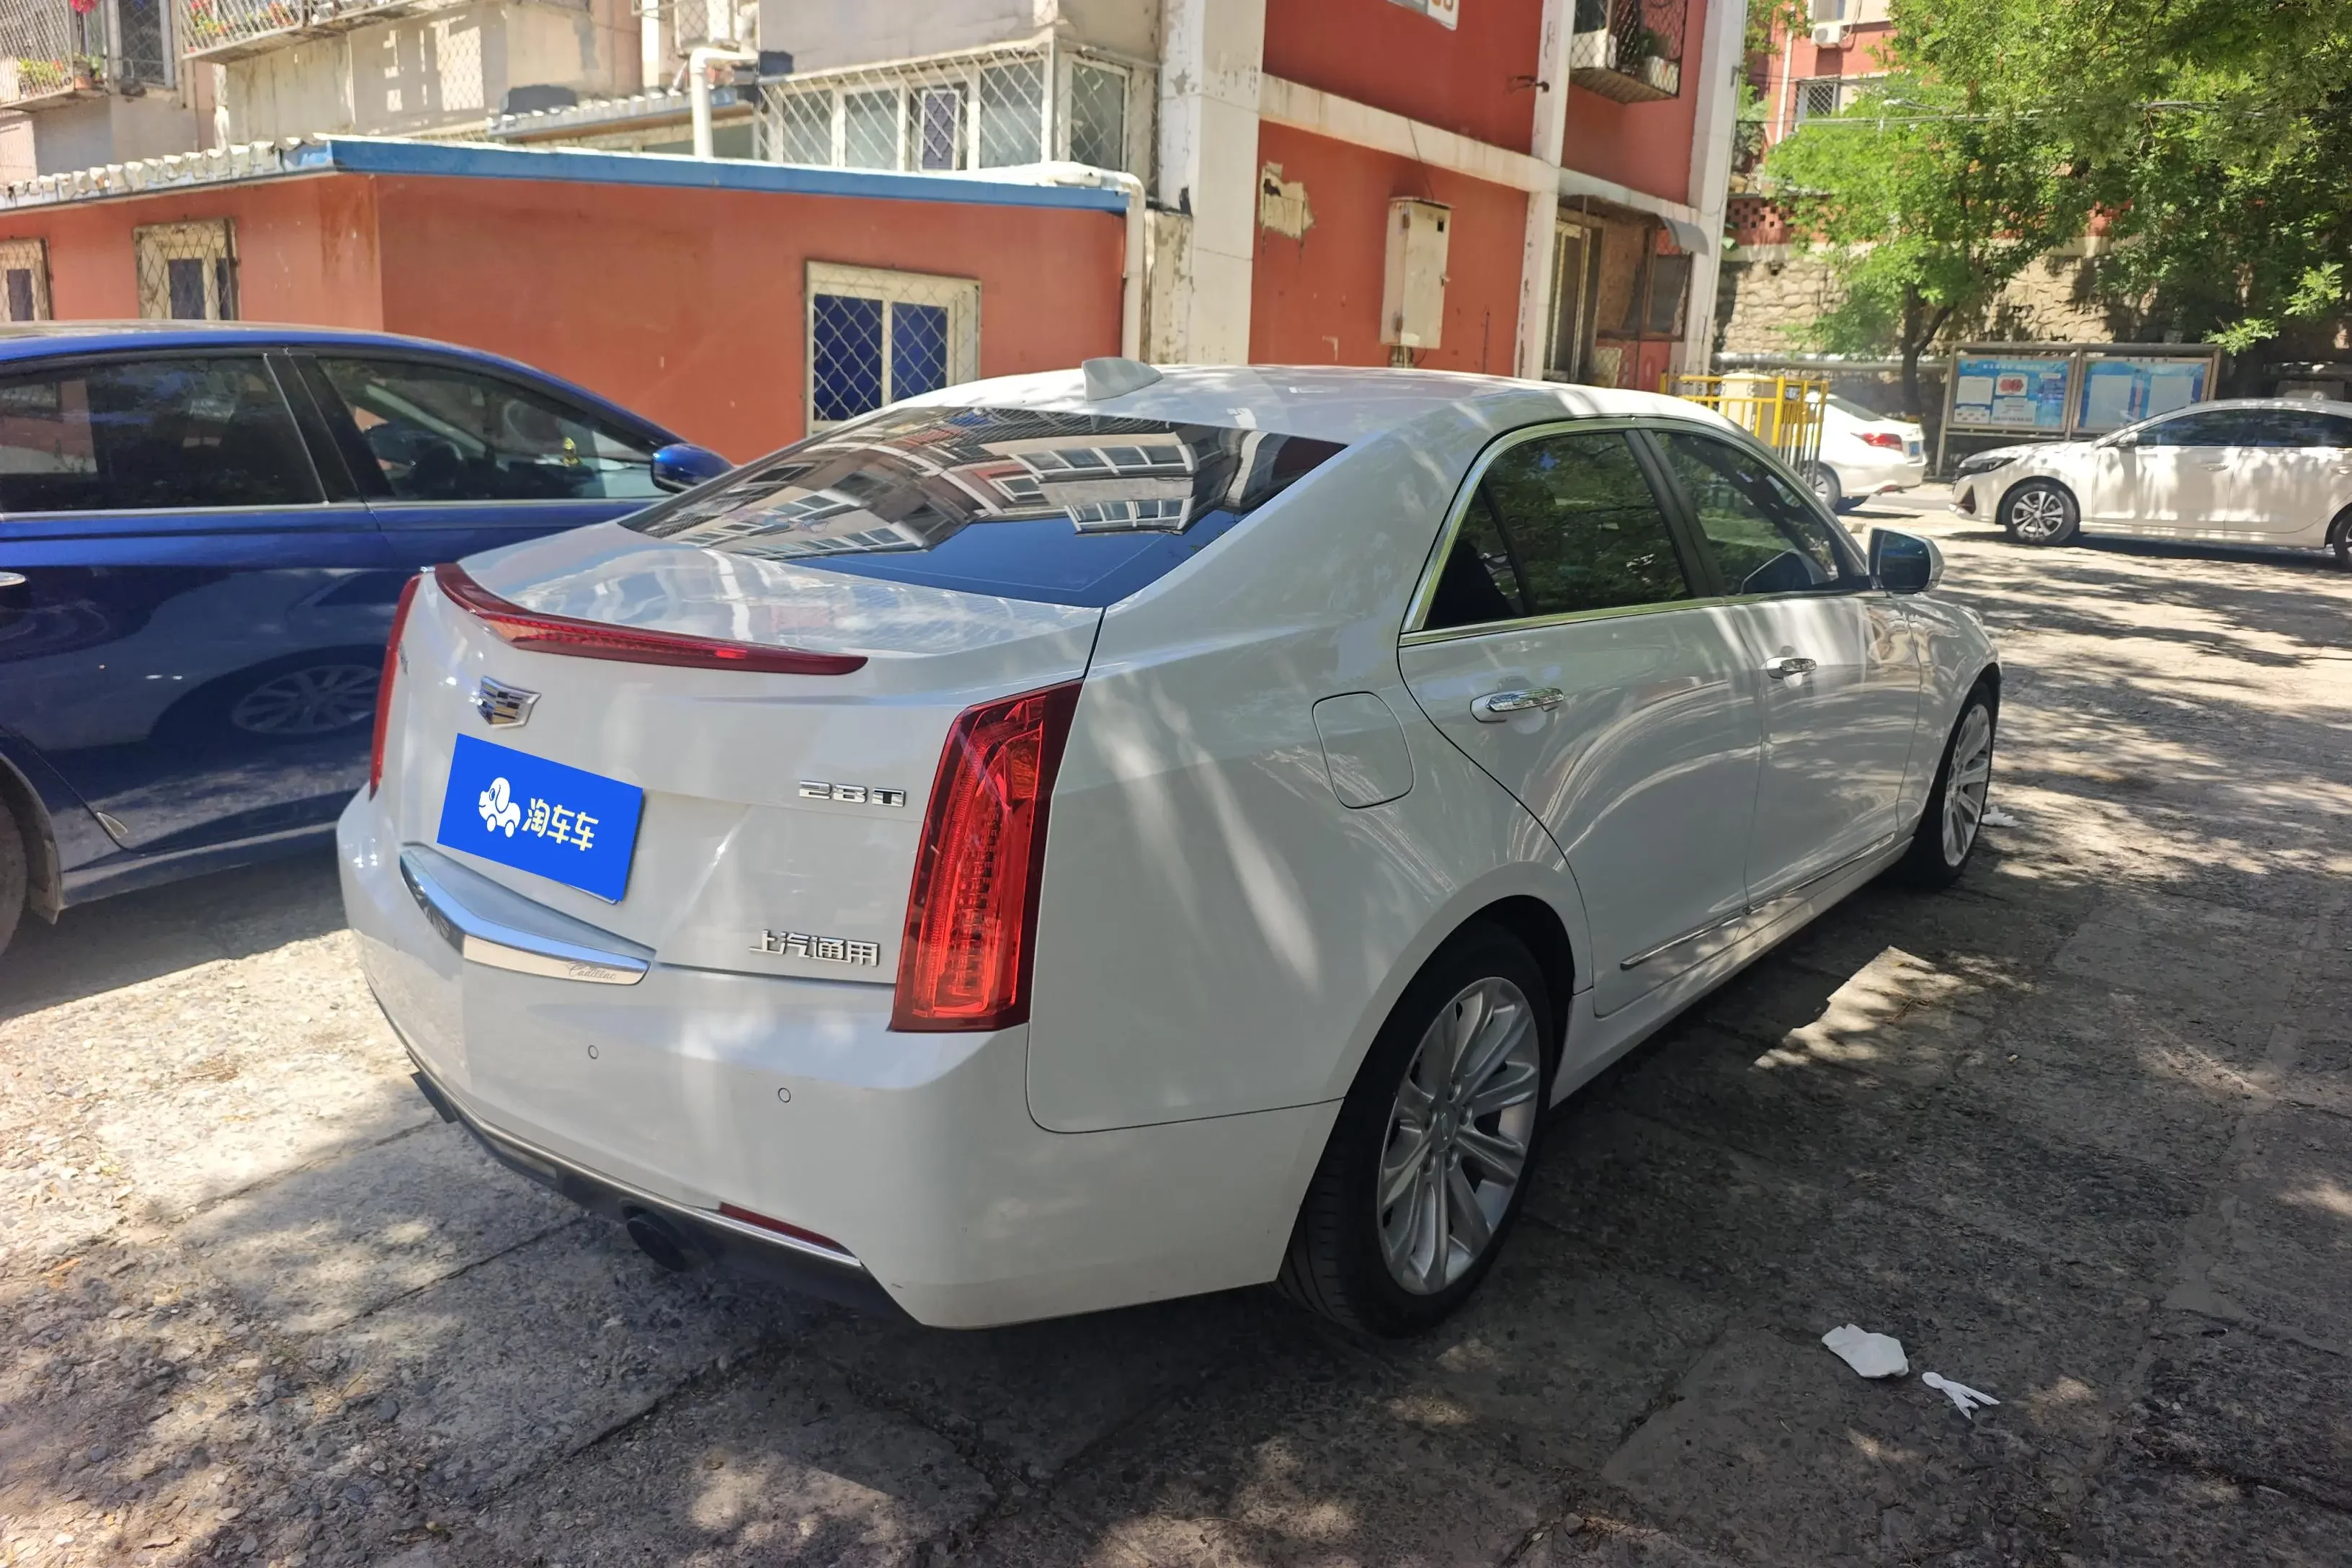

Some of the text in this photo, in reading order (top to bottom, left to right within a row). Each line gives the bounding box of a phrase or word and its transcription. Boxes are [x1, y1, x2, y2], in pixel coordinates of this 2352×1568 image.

[799, 780, 906, 808] 28T
[749, 929, 880, 967] 上汽通用
[566, 963, 618, 980] Cadillac
